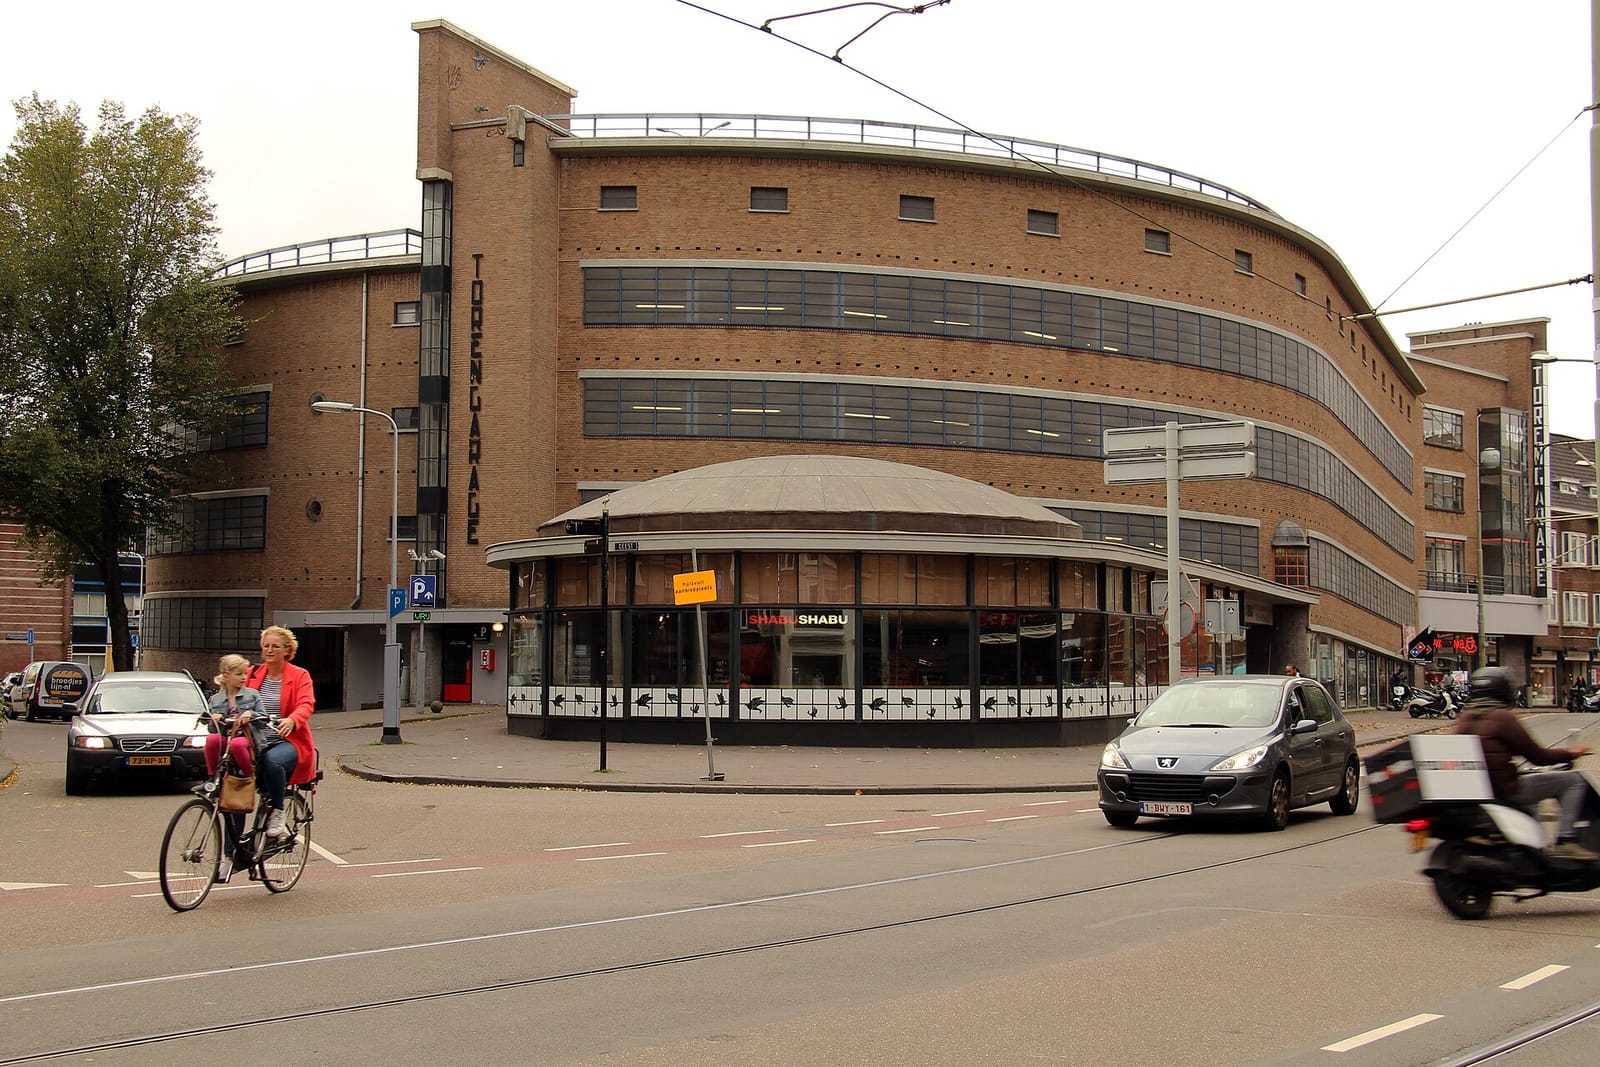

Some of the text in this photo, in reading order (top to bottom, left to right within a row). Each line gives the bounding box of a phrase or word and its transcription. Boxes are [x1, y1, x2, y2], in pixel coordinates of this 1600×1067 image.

[467, 253, 484, 545] TORENGARAGE
[414, 582, 425, 600] P
[394, 597, 401, 609] P
[1145, 803, 1190, 813] 1-BWY-161
